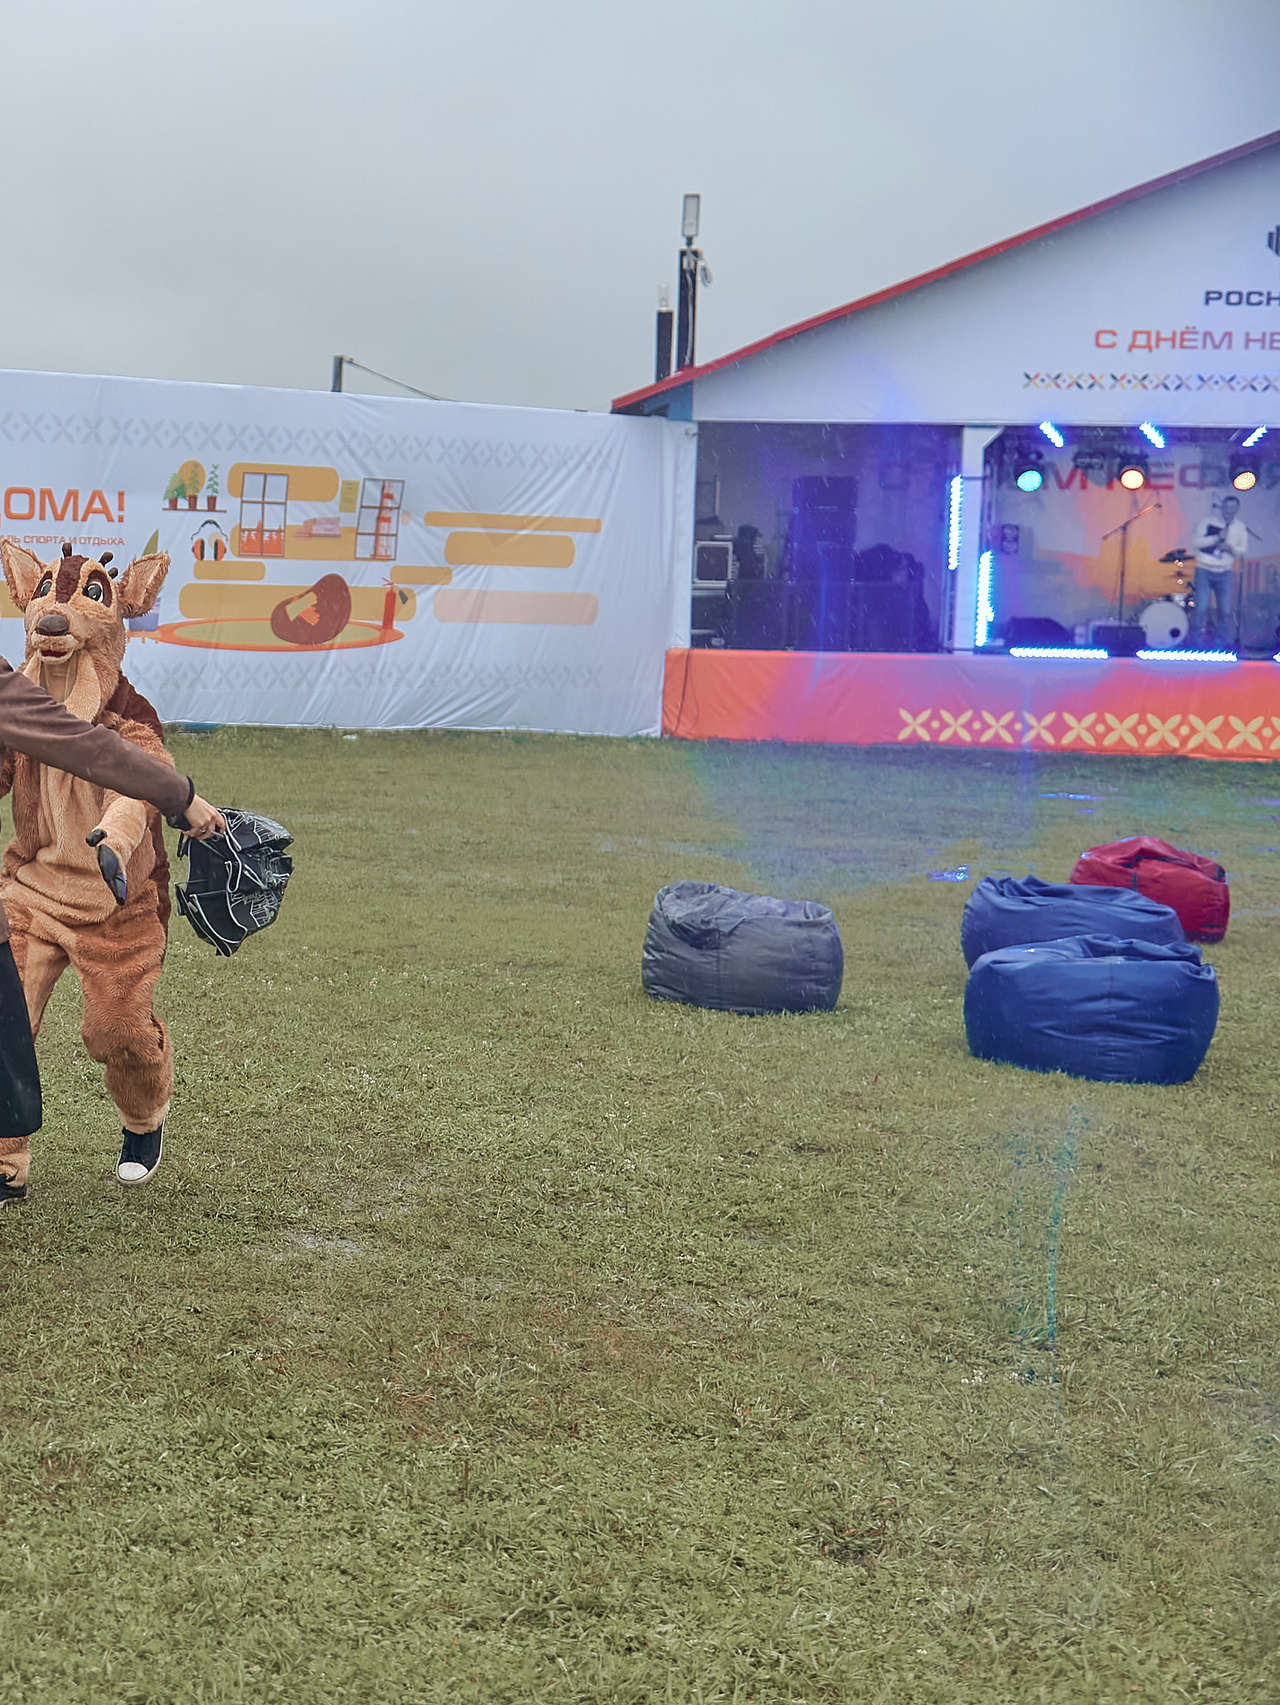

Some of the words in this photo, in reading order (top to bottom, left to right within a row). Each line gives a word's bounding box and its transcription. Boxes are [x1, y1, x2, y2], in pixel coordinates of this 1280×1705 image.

[1203, 289, 1280, 306] РОСН
[1095, 329, 1118, 349] С
[1128, 325, 1233, 353] ДНЁМ
[23, 535, 66, 544] СПОРТА
[69, 536, 77, 544] И
[79, 536, 125, 546] ОТДЫХА
